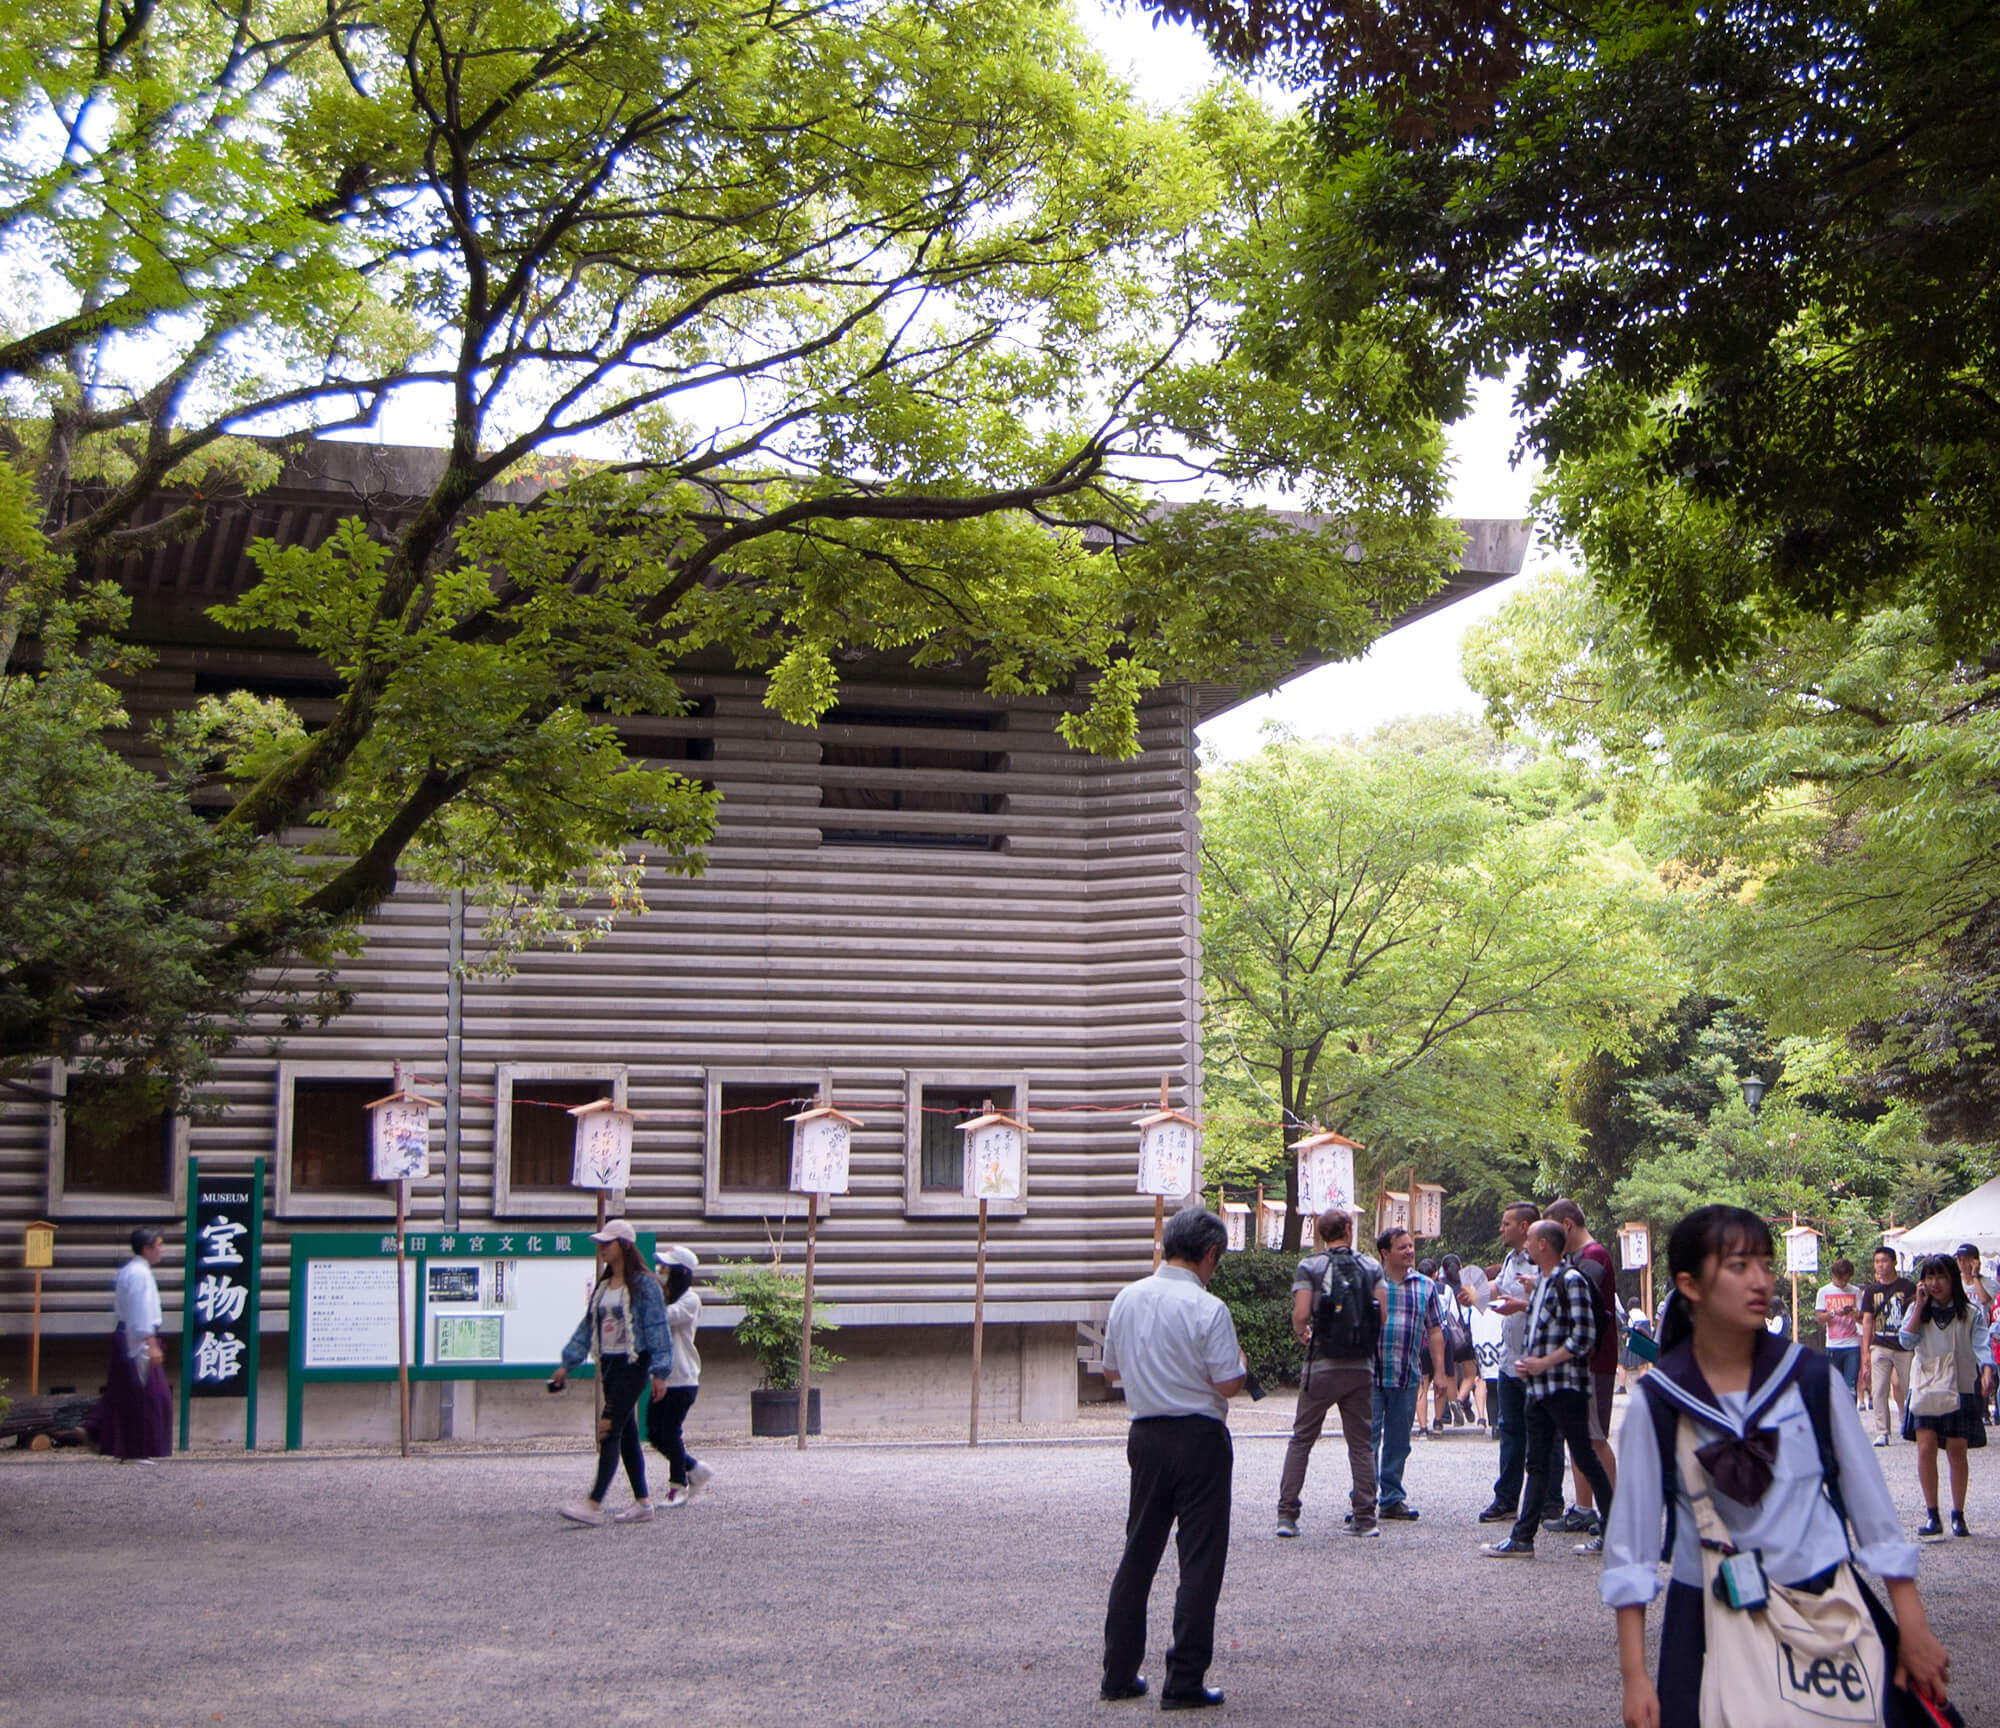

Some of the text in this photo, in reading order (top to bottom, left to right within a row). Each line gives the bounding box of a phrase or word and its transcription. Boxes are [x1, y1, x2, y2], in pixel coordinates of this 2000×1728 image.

[202, 1193, 249, 1202] MUSEUM
[381, 1236, 572, 1251] 熱田神宮文化殿
[195, 1215, 249, 1380] 宝物館
[1779, 1640, 1866, 1702] Lee
